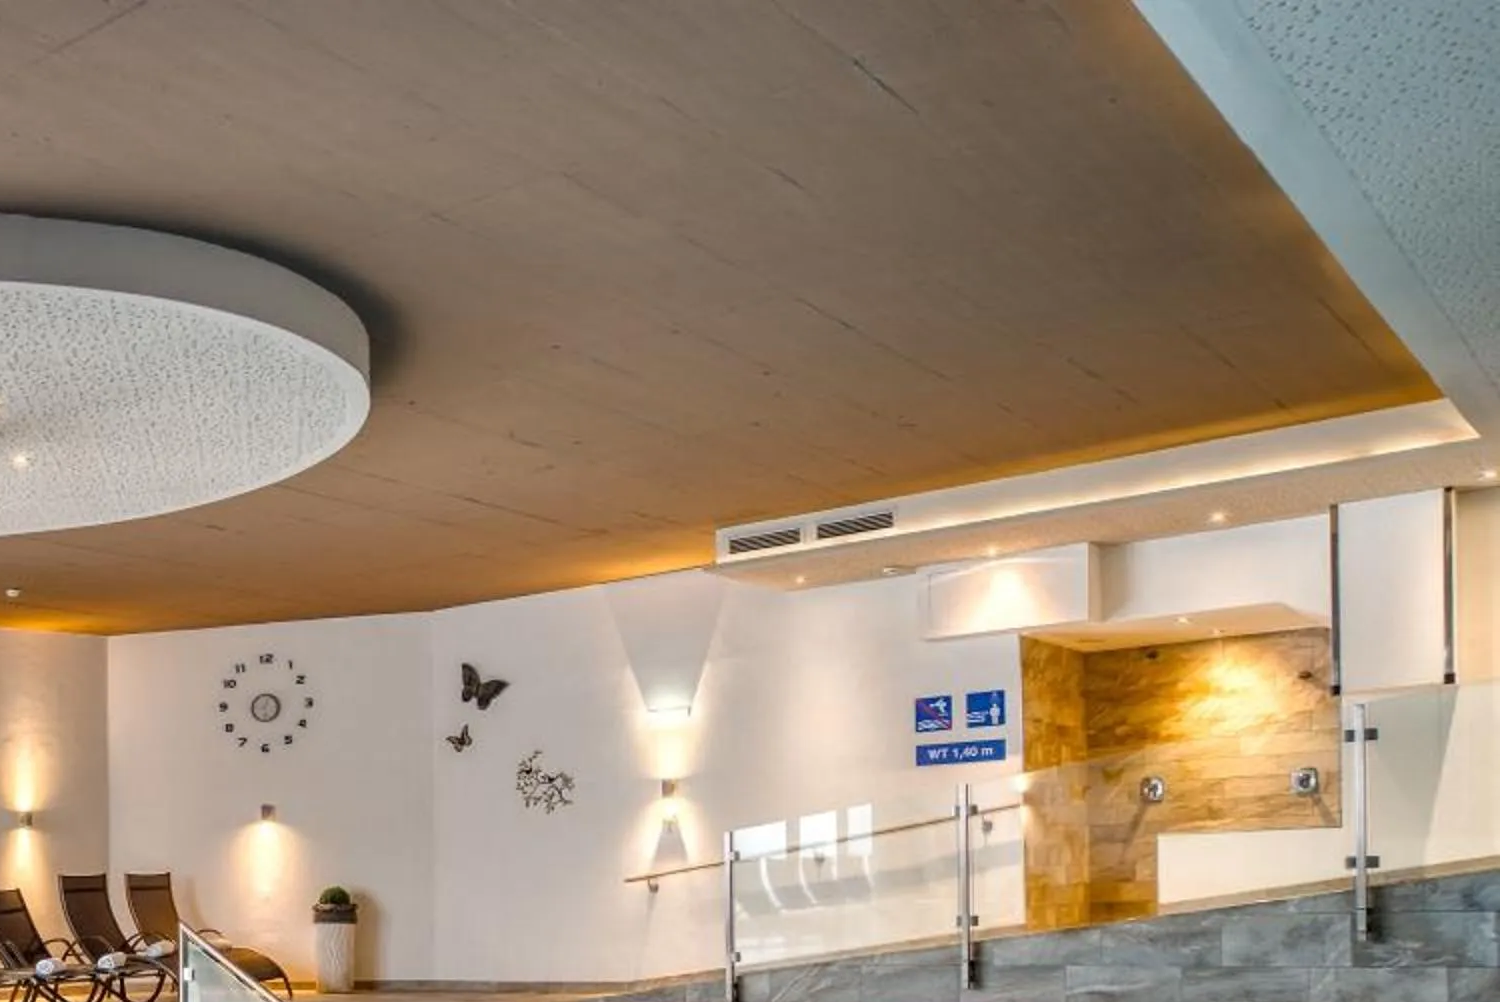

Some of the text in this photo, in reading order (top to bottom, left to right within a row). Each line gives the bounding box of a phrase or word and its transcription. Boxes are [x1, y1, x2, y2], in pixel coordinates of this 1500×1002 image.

[259, 653, 274, 664] 12
[235, 663, 246, 673] 11
[288, 659, 293, 670] 1
[223, 679, 237, 689] 10
[295, 675, 306, 685] 2
[219, 702, 229, 712] 9
[304, 697, 314, 708] 3
[225, 723, 234, 733] 8
[297, 719, 307, 728] 4
[238, 737, 248, 747] 7
[284, 735, 293, 745] 5
[261, 743, 270, 753] 6
[927, 745, 994, 761] WT 1,40 m
